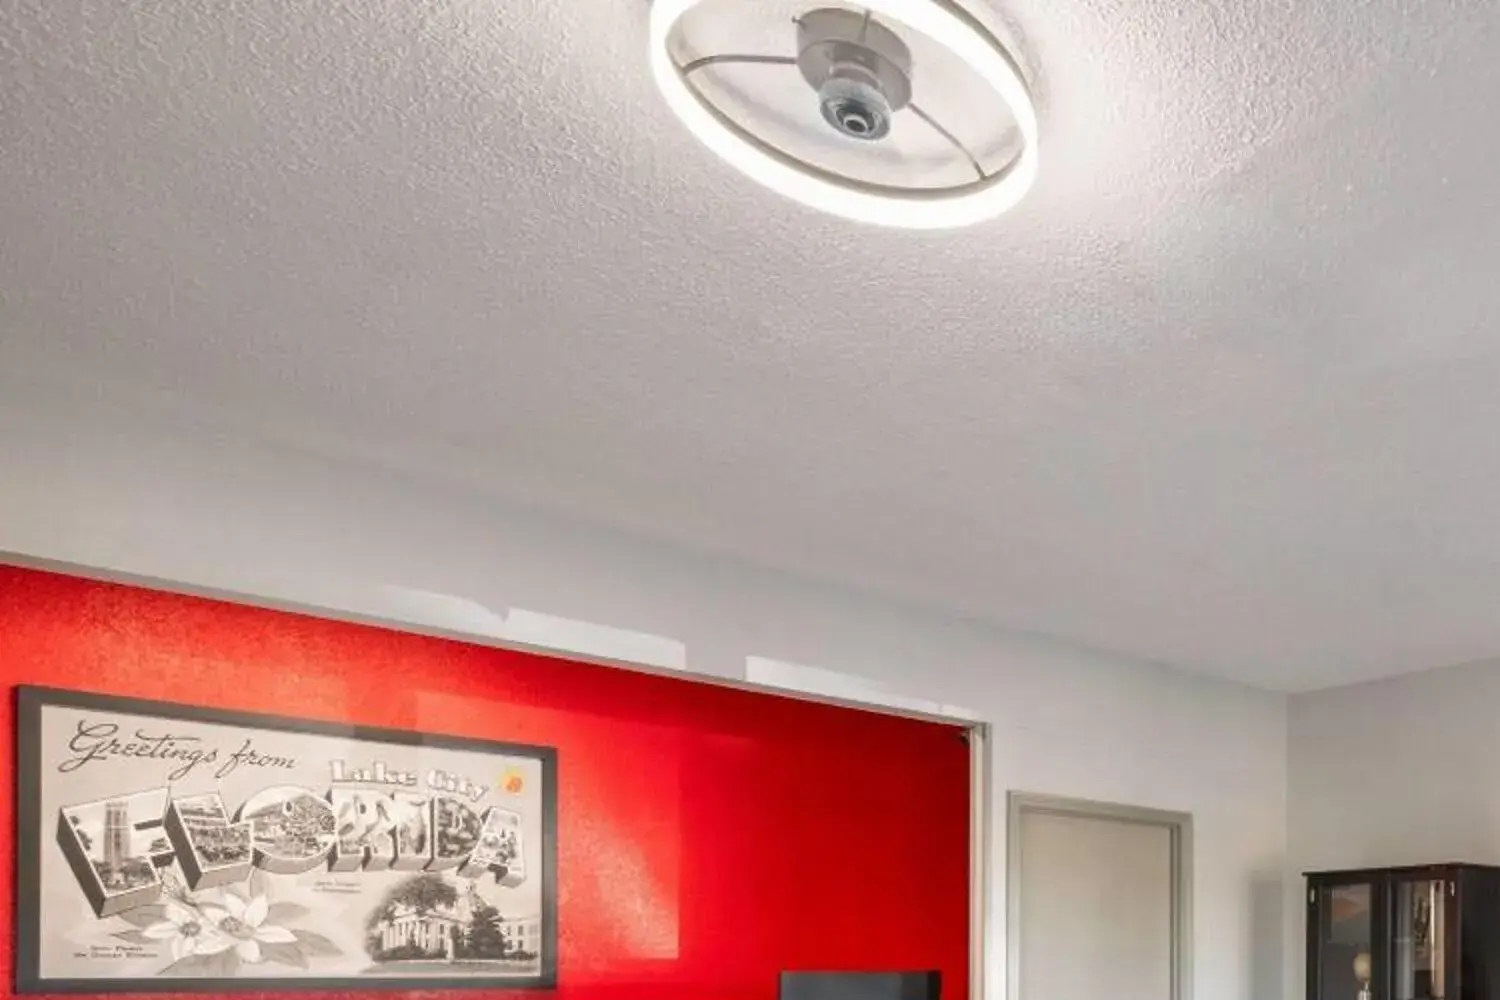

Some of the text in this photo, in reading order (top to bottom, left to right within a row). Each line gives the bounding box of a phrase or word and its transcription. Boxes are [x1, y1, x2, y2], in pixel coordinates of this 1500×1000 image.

[57, 719, 297, 781] Greetings from
[329, 759, 490, 803] Lake City
[56, 785, 526, 919] FLORIDA
